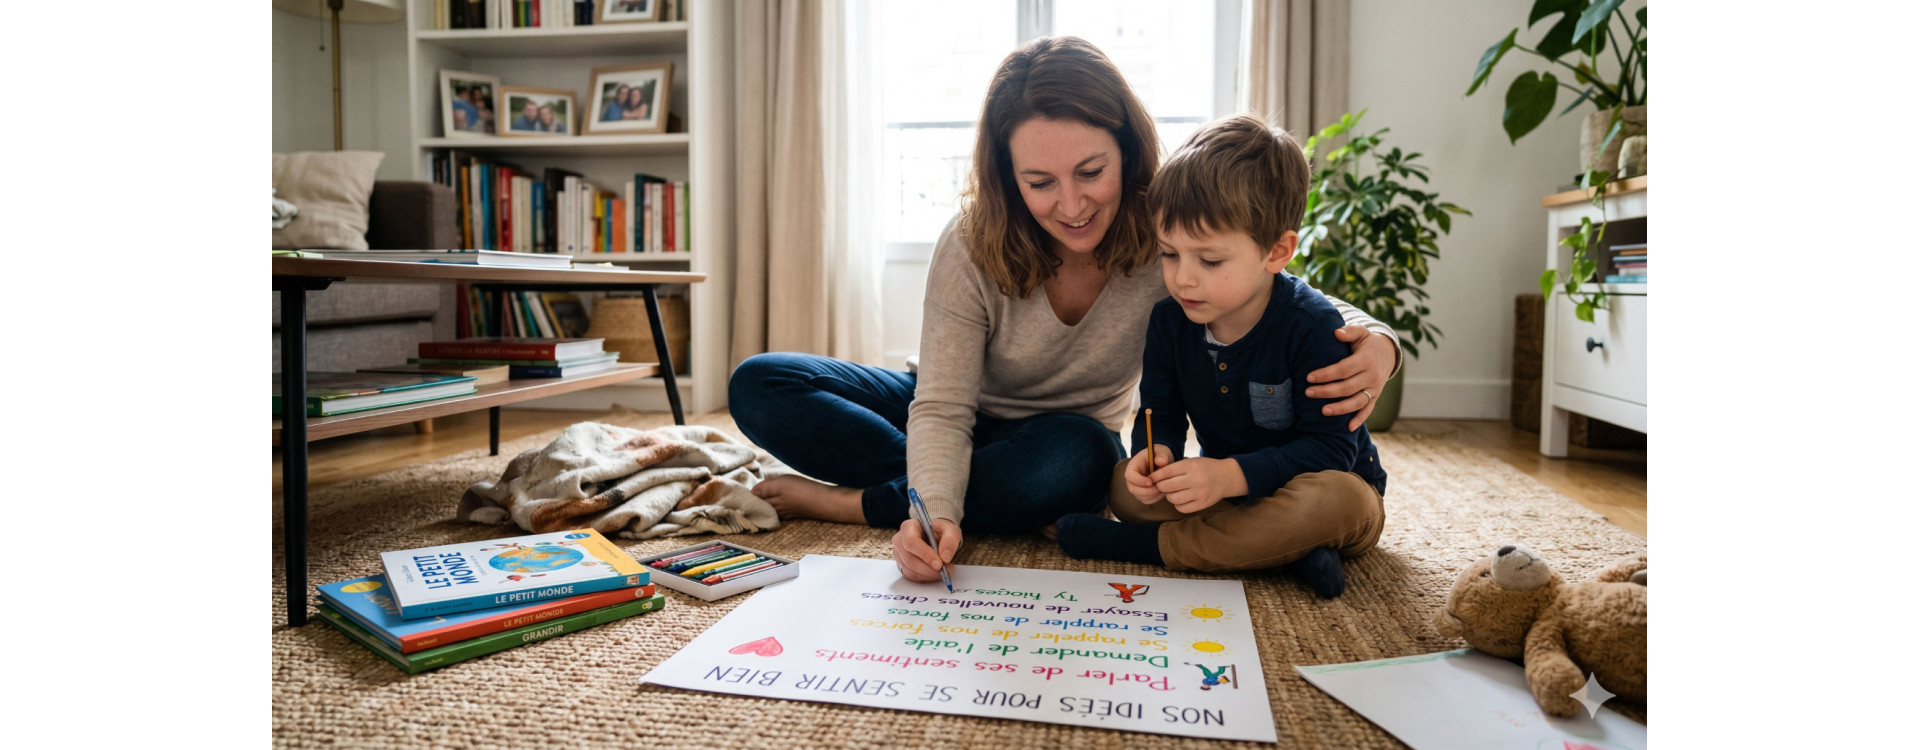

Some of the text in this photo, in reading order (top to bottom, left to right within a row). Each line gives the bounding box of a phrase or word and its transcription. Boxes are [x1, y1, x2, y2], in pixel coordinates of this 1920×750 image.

[413, 555, 446, 577] PETIT
[439, 552, 480, 585] MONDE
[424, 577, 452, 590] LE
[495, 585, 574, 604] LE PETIT MONDE
[1054, 591, 1078, 602] Ty
[938, 597, 1035, 612] nouvelles
[1045, 604, 1070, 615] de
[503, 619, 513, 628] LE
[514, 615, 534, 625] PETIT
[887, 608, 950, 622] forces
[960, 612, 995, 622] nos
[1003, 615, 1030, 627] de
[1081, 606, 1169, 622] Essayer
[522, 624, 564, 642] GRANDIR
[848, 618, 1169, 651] Se rappeler de nos forces
[1140, 624, 1169, 636] Se
[904, 638, 1169, 668] Demander de l'aide
[814, 649, 1176, 692] Parler de ses sentiments
[703, 665, 1225, 727] NOS IDÉÉS POUR SE SENTIR BIEN
